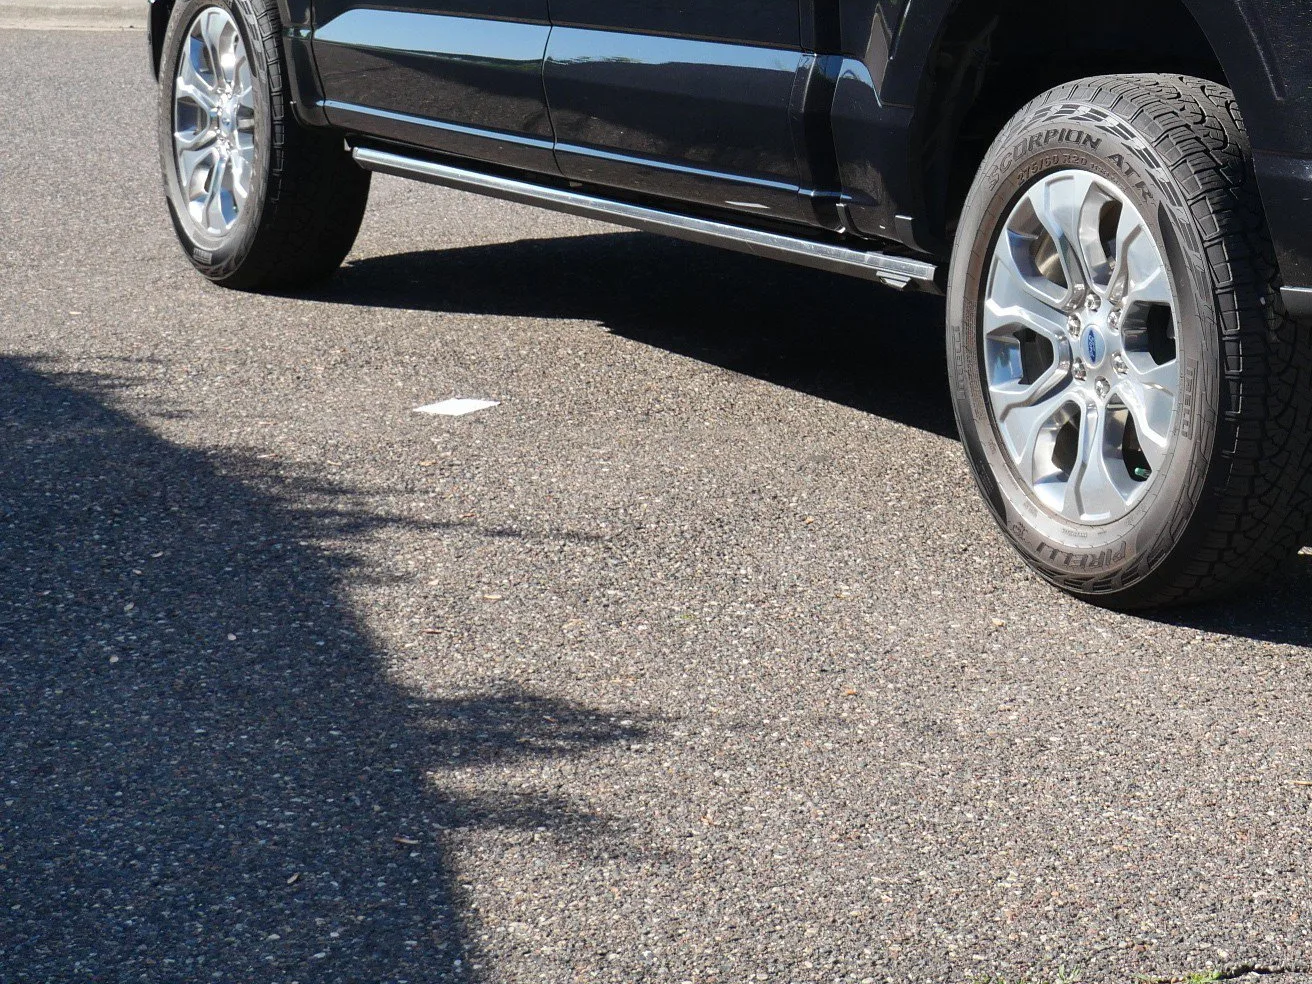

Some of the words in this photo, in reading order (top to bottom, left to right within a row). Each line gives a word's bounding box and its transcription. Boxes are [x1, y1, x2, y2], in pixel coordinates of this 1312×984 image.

[988, 128, 1102, 192] SCORPION
[1017, 154, 1059, 186] 275/60
[1036, 541, 1126, 567] PIRELLI
